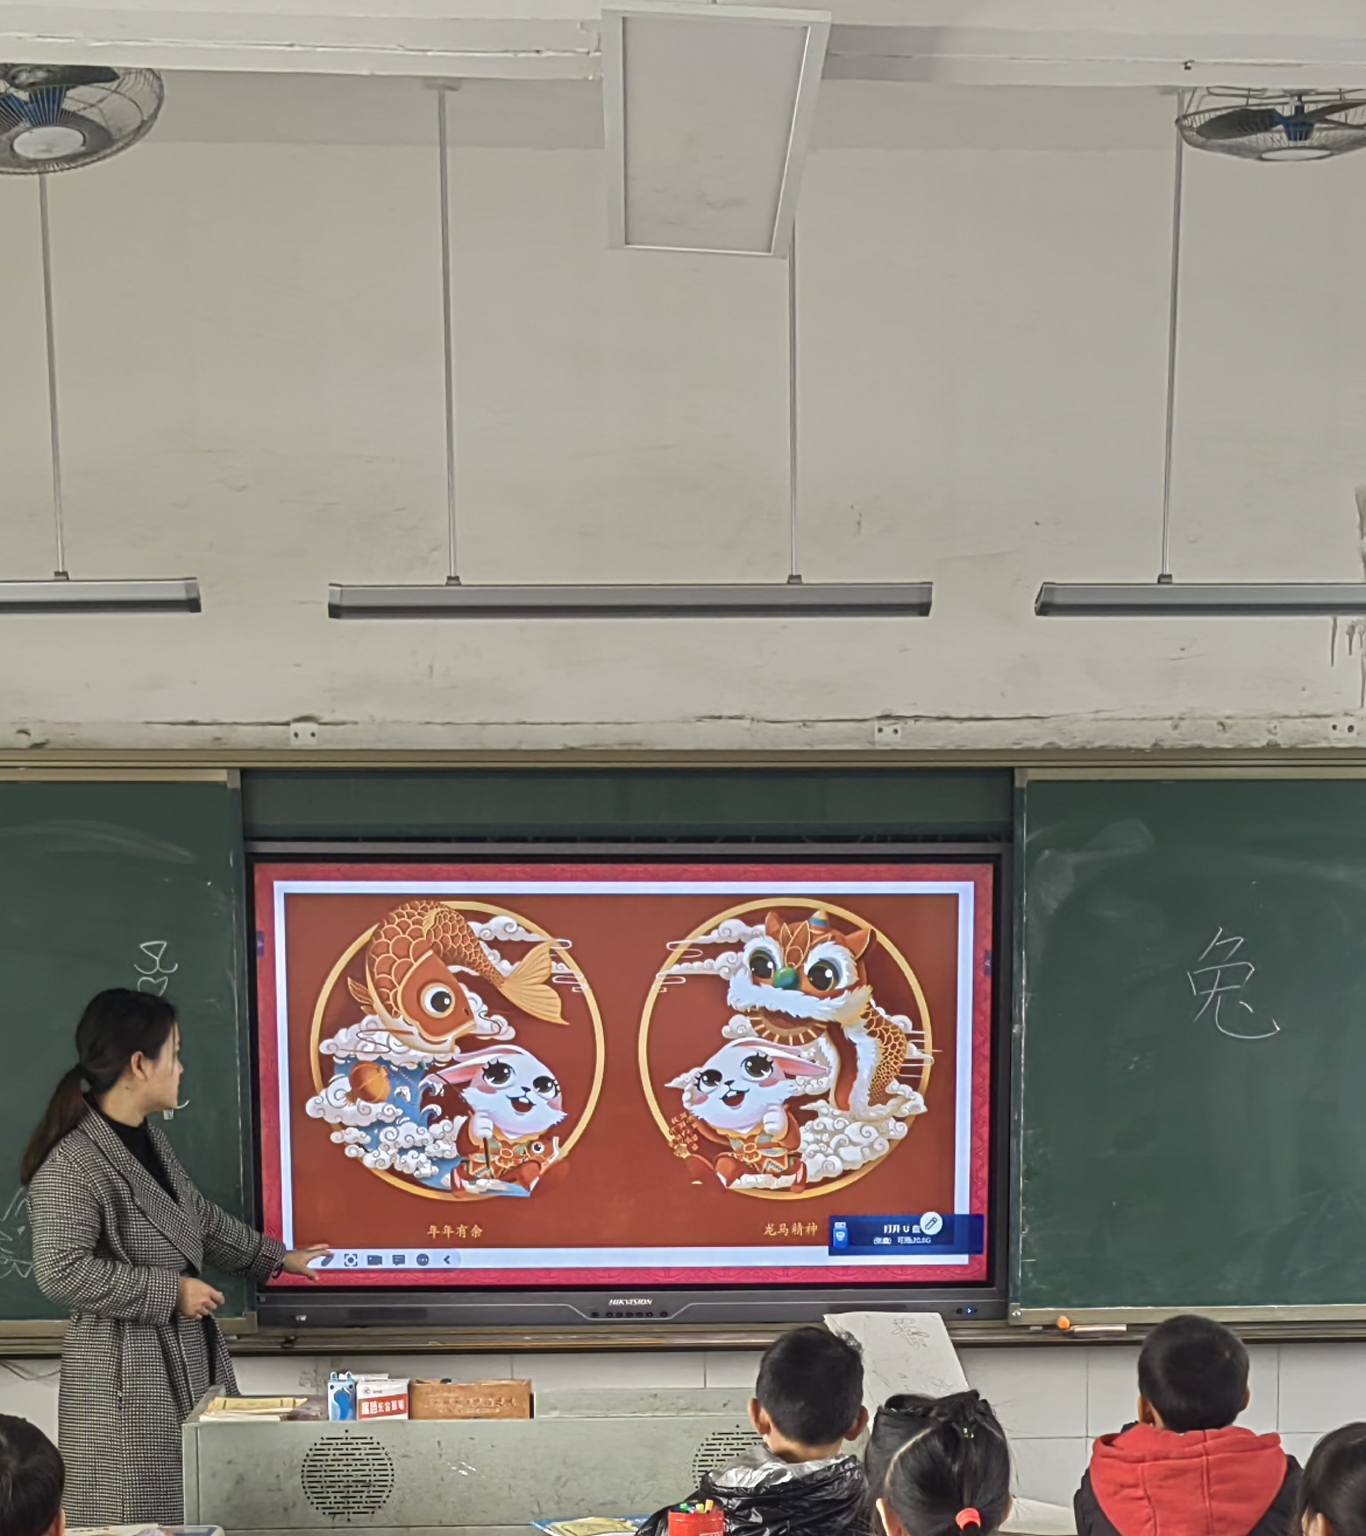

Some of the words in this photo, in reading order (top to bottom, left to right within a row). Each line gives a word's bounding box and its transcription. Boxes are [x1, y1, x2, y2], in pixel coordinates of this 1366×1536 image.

[1187, 927, 1280, 1039] 兔
[426, 1224, 483, 1239] 年年有余
[763, 1222, 818, 1237] 龙马精神
[608, 1298, 653, 1306] HIKVISION
